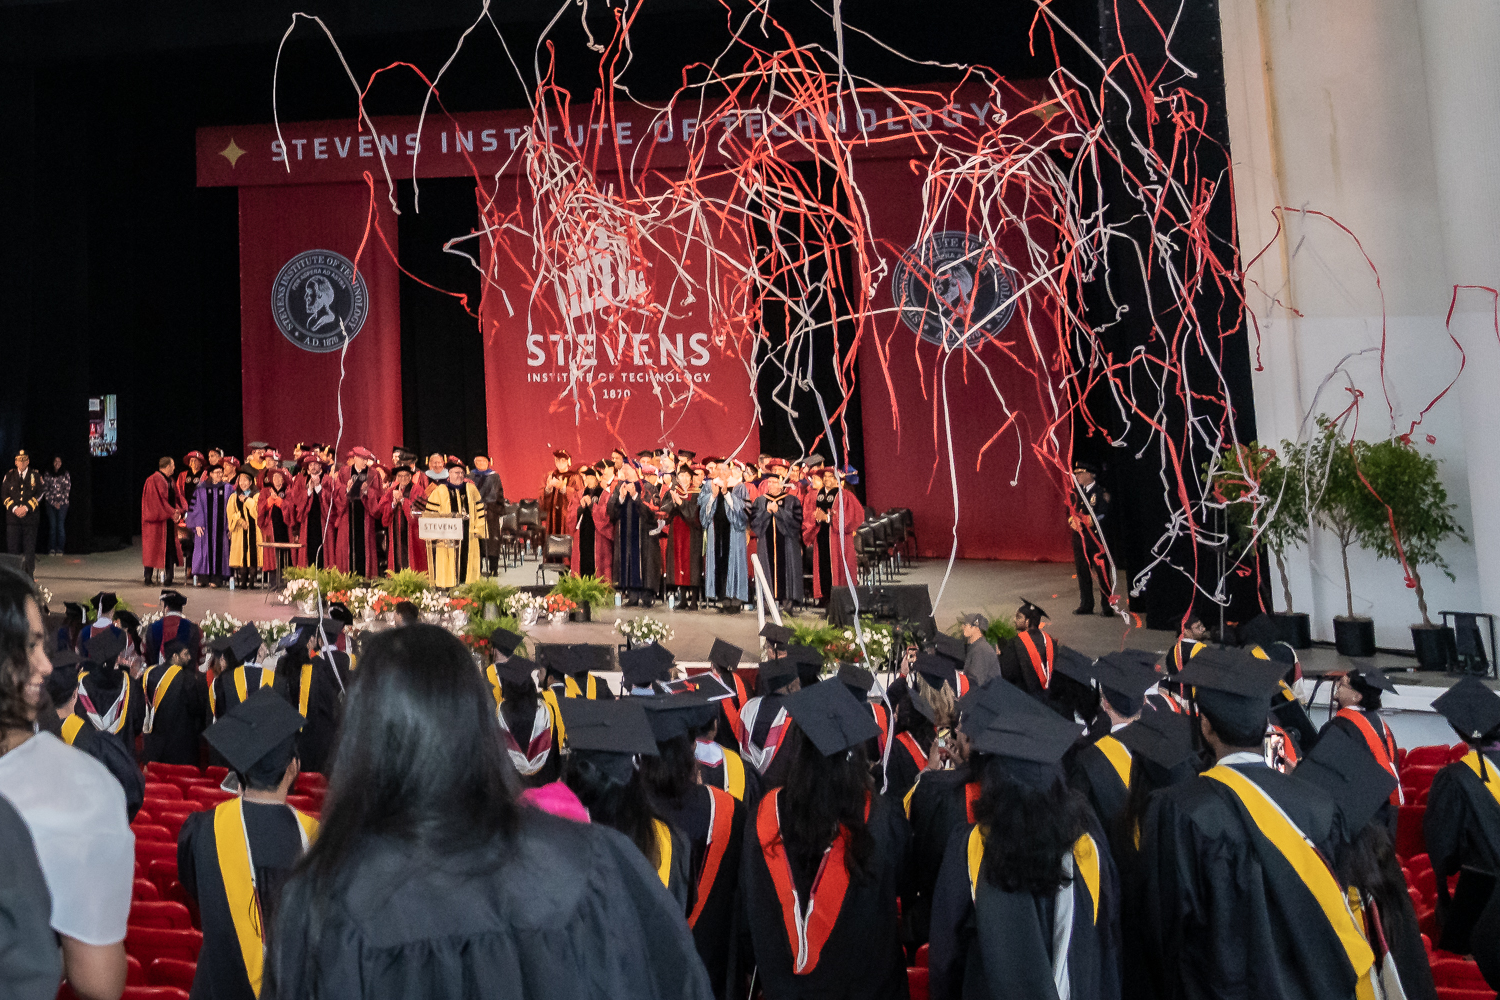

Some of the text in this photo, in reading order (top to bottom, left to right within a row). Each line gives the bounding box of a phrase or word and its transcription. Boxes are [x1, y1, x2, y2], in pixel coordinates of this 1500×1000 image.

[271, 133, 422, 162] STEVENS
[441, 121, 633, 153] INSTTUTE
[654, 117, 699, 144] OF
[527, 333, 711, 367] STEVENS
[527, 372, 711, 383] INSTITTE OF TECNOLGY
[602, 388, 631, 400] 1870
[424, 522, 458, 531] STEVENS
